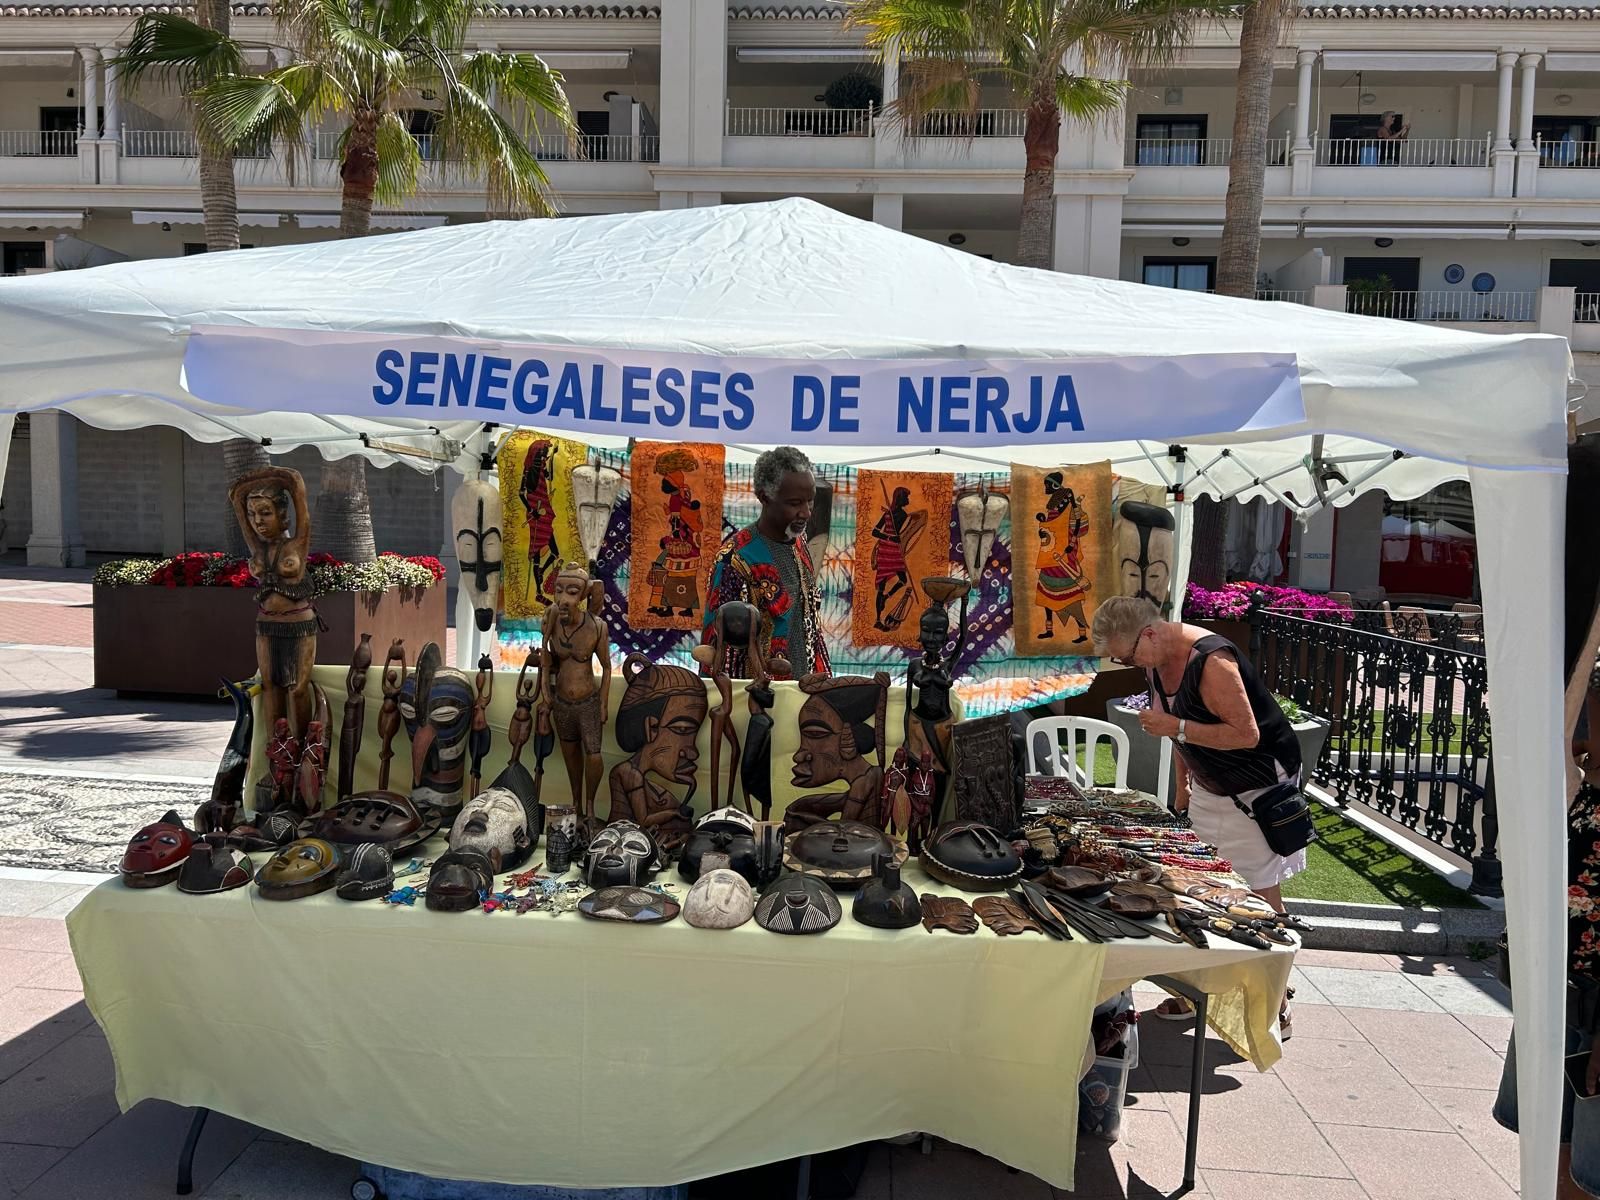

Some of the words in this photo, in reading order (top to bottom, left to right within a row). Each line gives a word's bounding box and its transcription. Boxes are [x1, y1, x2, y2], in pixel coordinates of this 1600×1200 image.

[373, 350, 755, 431] SENEGALESES
[792, 375, 861, 433] DE
[896, 375, 1085, 434] NERJA
